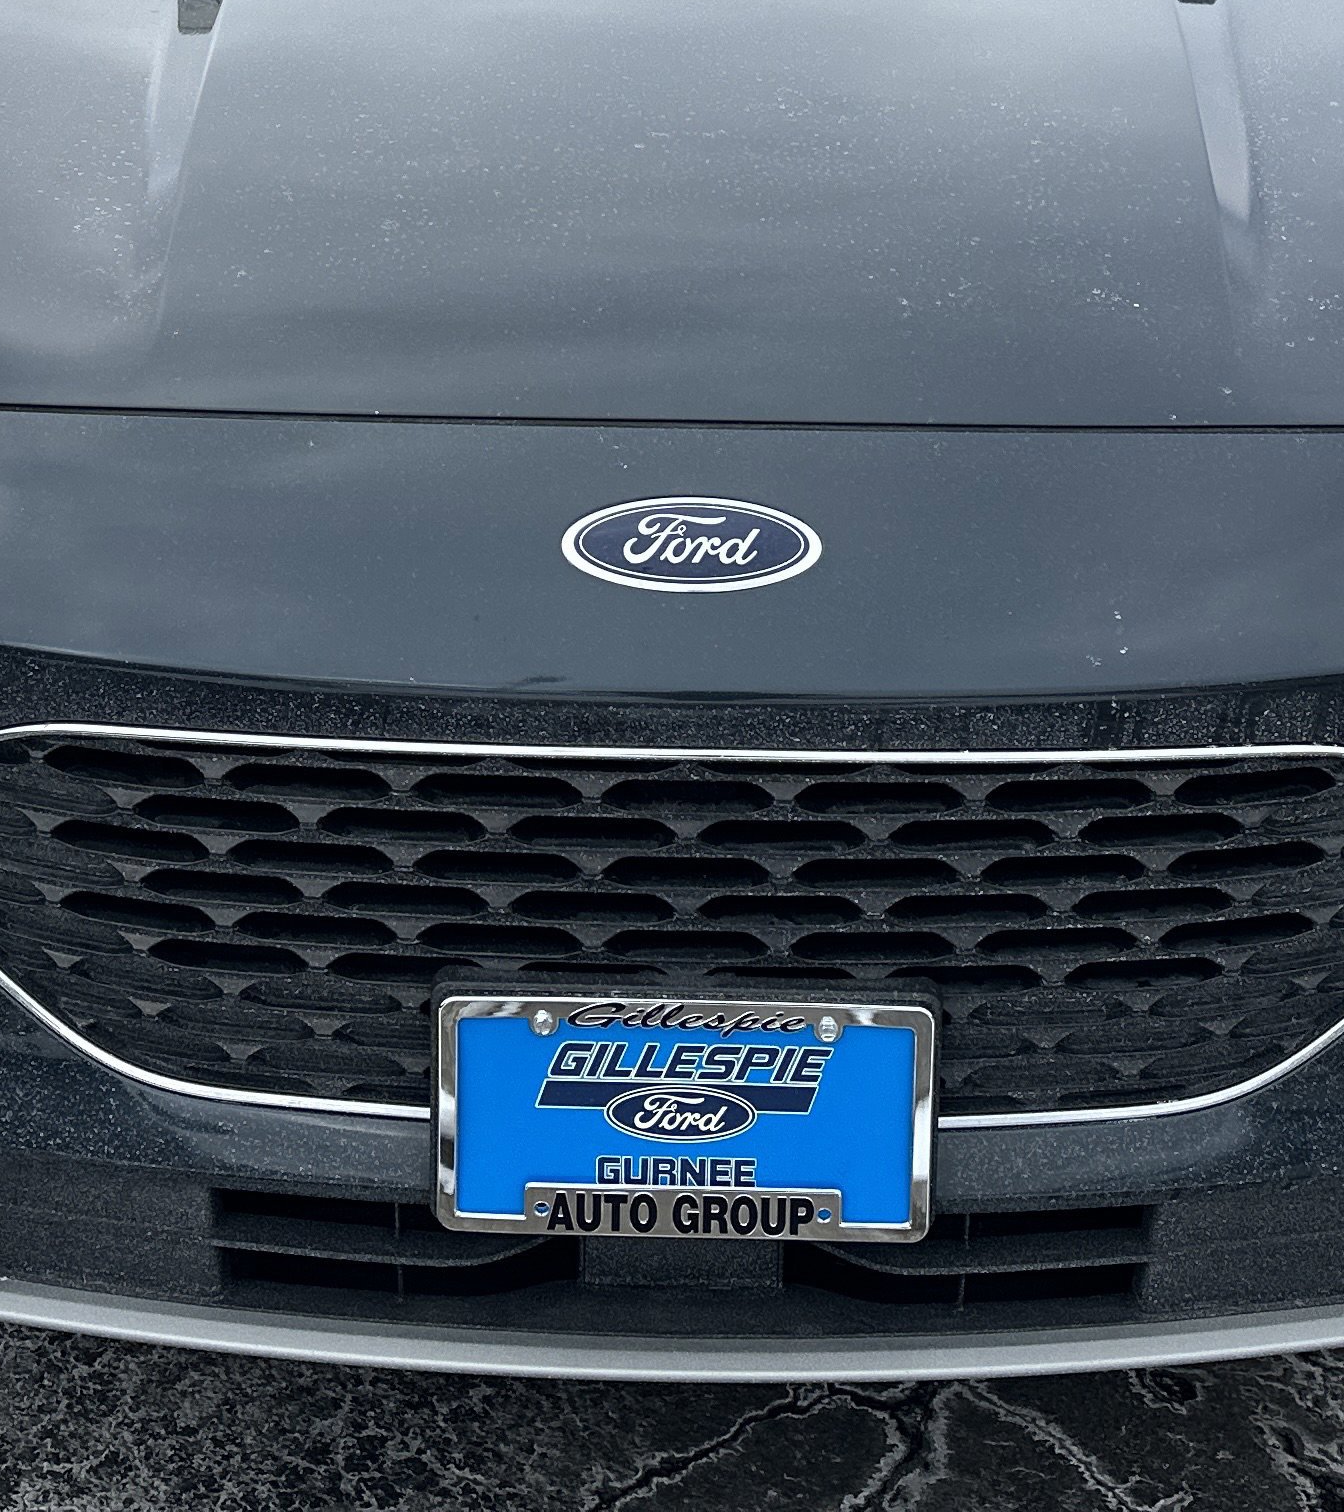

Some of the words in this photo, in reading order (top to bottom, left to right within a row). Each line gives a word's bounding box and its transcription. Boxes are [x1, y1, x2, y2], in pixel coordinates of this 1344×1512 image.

[622, 513, 761, 566] Ford
[567, 1001, 807, 1039] Gillespie
[548, 1041, 834, 1085] GILLESPIE
[633, 1094, 728, 1133] Ford
[595, 1155, 757, 1187] GURNEE
[546, 1189, 658, 1234] AUTO
[672, 1192, 815, 1237] GROUP
